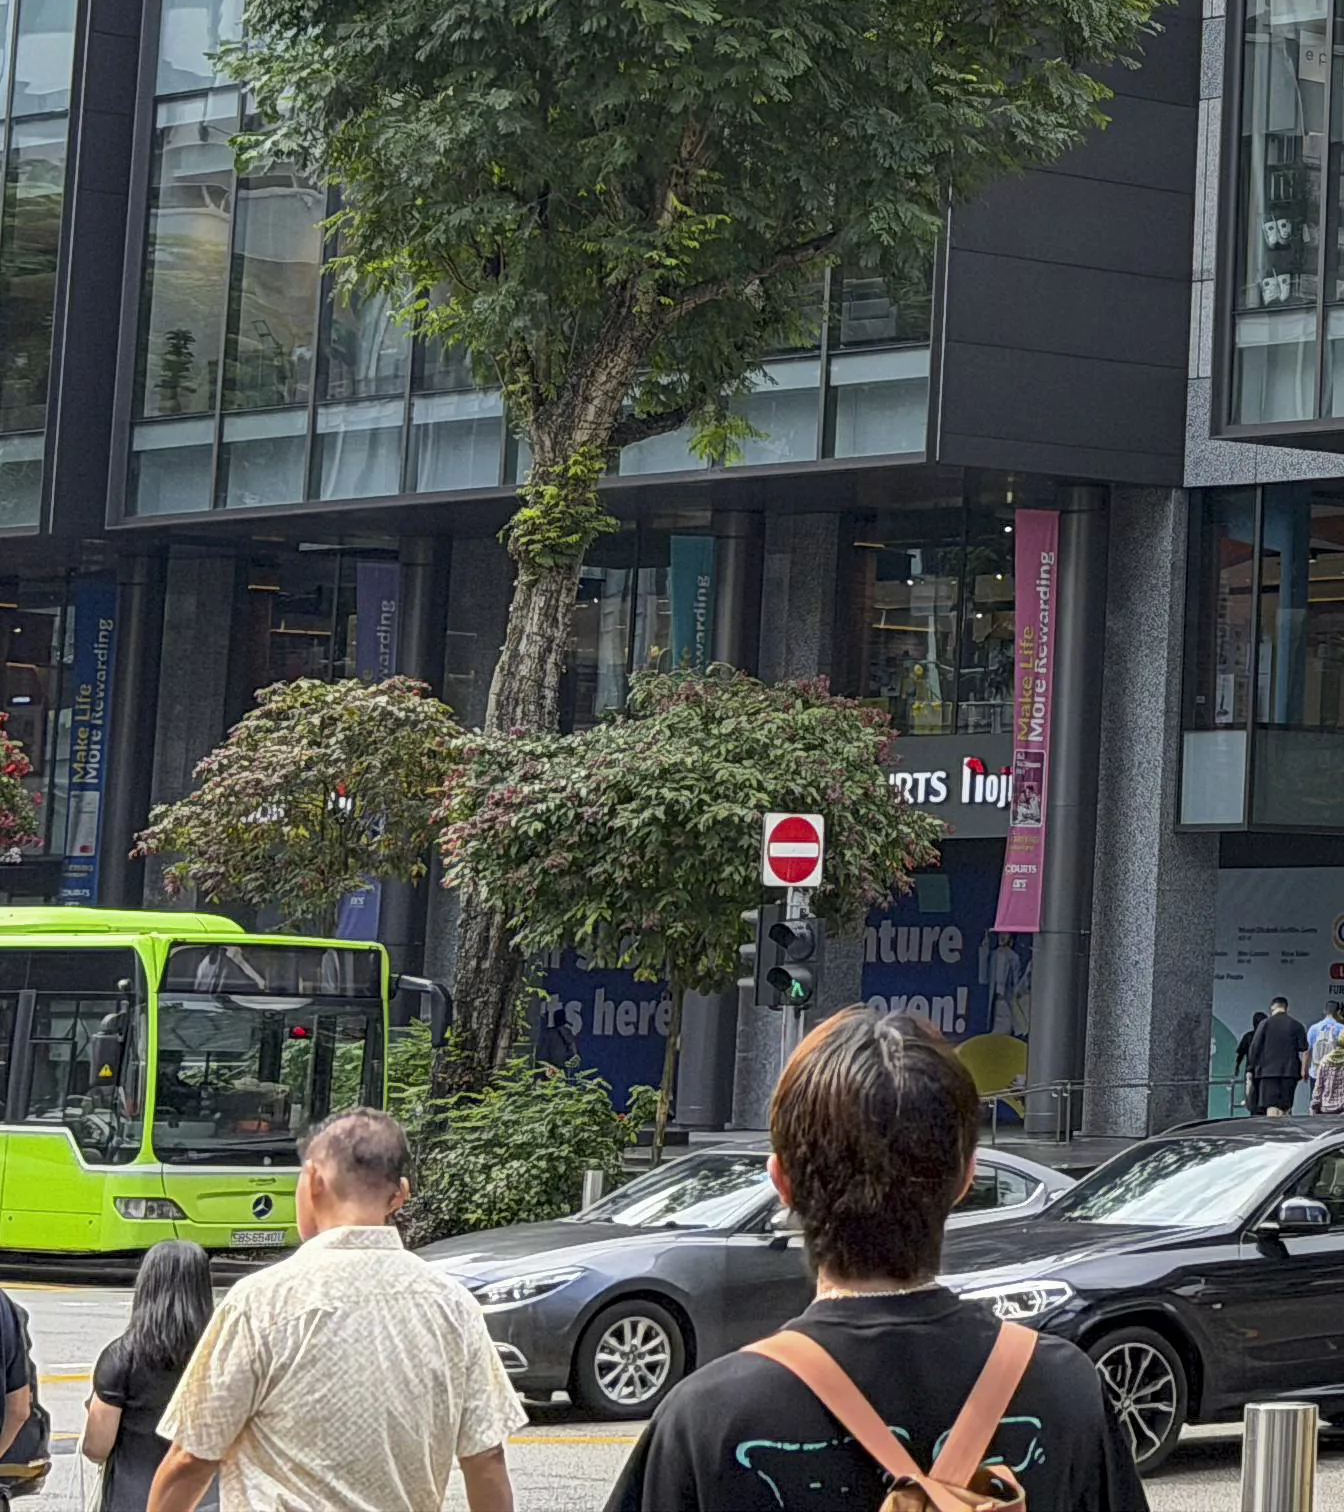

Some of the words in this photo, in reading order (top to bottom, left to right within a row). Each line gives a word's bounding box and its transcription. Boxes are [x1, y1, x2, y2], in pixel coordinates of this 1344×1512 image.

[1035, 552, 1055, 674] Rewarding
[92, 619, 114, 724] Rewarding
[1019, 626, 1034, 670] Life
[75, 684, 93, 721] Life
[1018, 676, 1034, 744] Make
[1028, 679, 1047, 742] More
[72, 727, 90, 783] Make
[85, 730, 103, 783] More
[593, 987, 673, 1037] here
